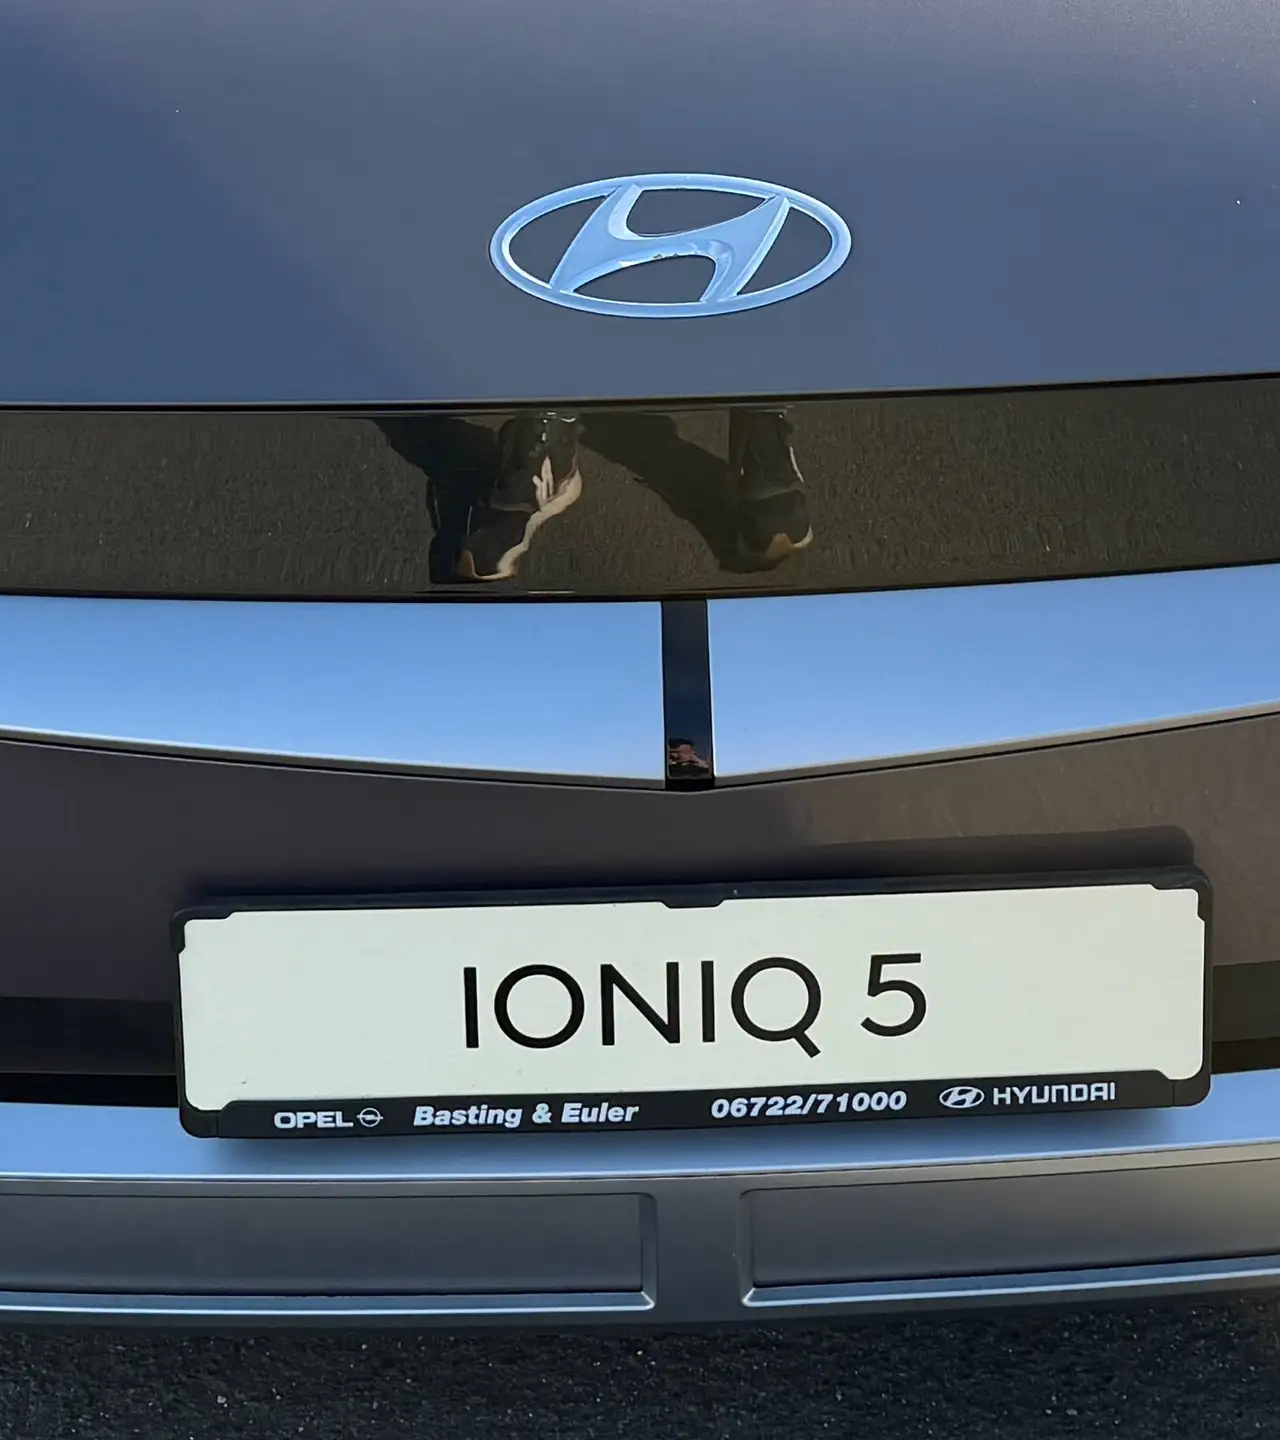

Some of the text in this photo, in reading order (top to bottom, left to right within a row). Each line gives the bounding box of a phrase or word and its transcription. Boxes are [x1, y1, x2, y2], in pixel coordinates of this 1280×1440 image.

[463, 953, 927, 1058] IONIQ 5
[273, 1082, 1116, 1129] OPEL Basting & Euler 06722/71000 HYUNDAI
